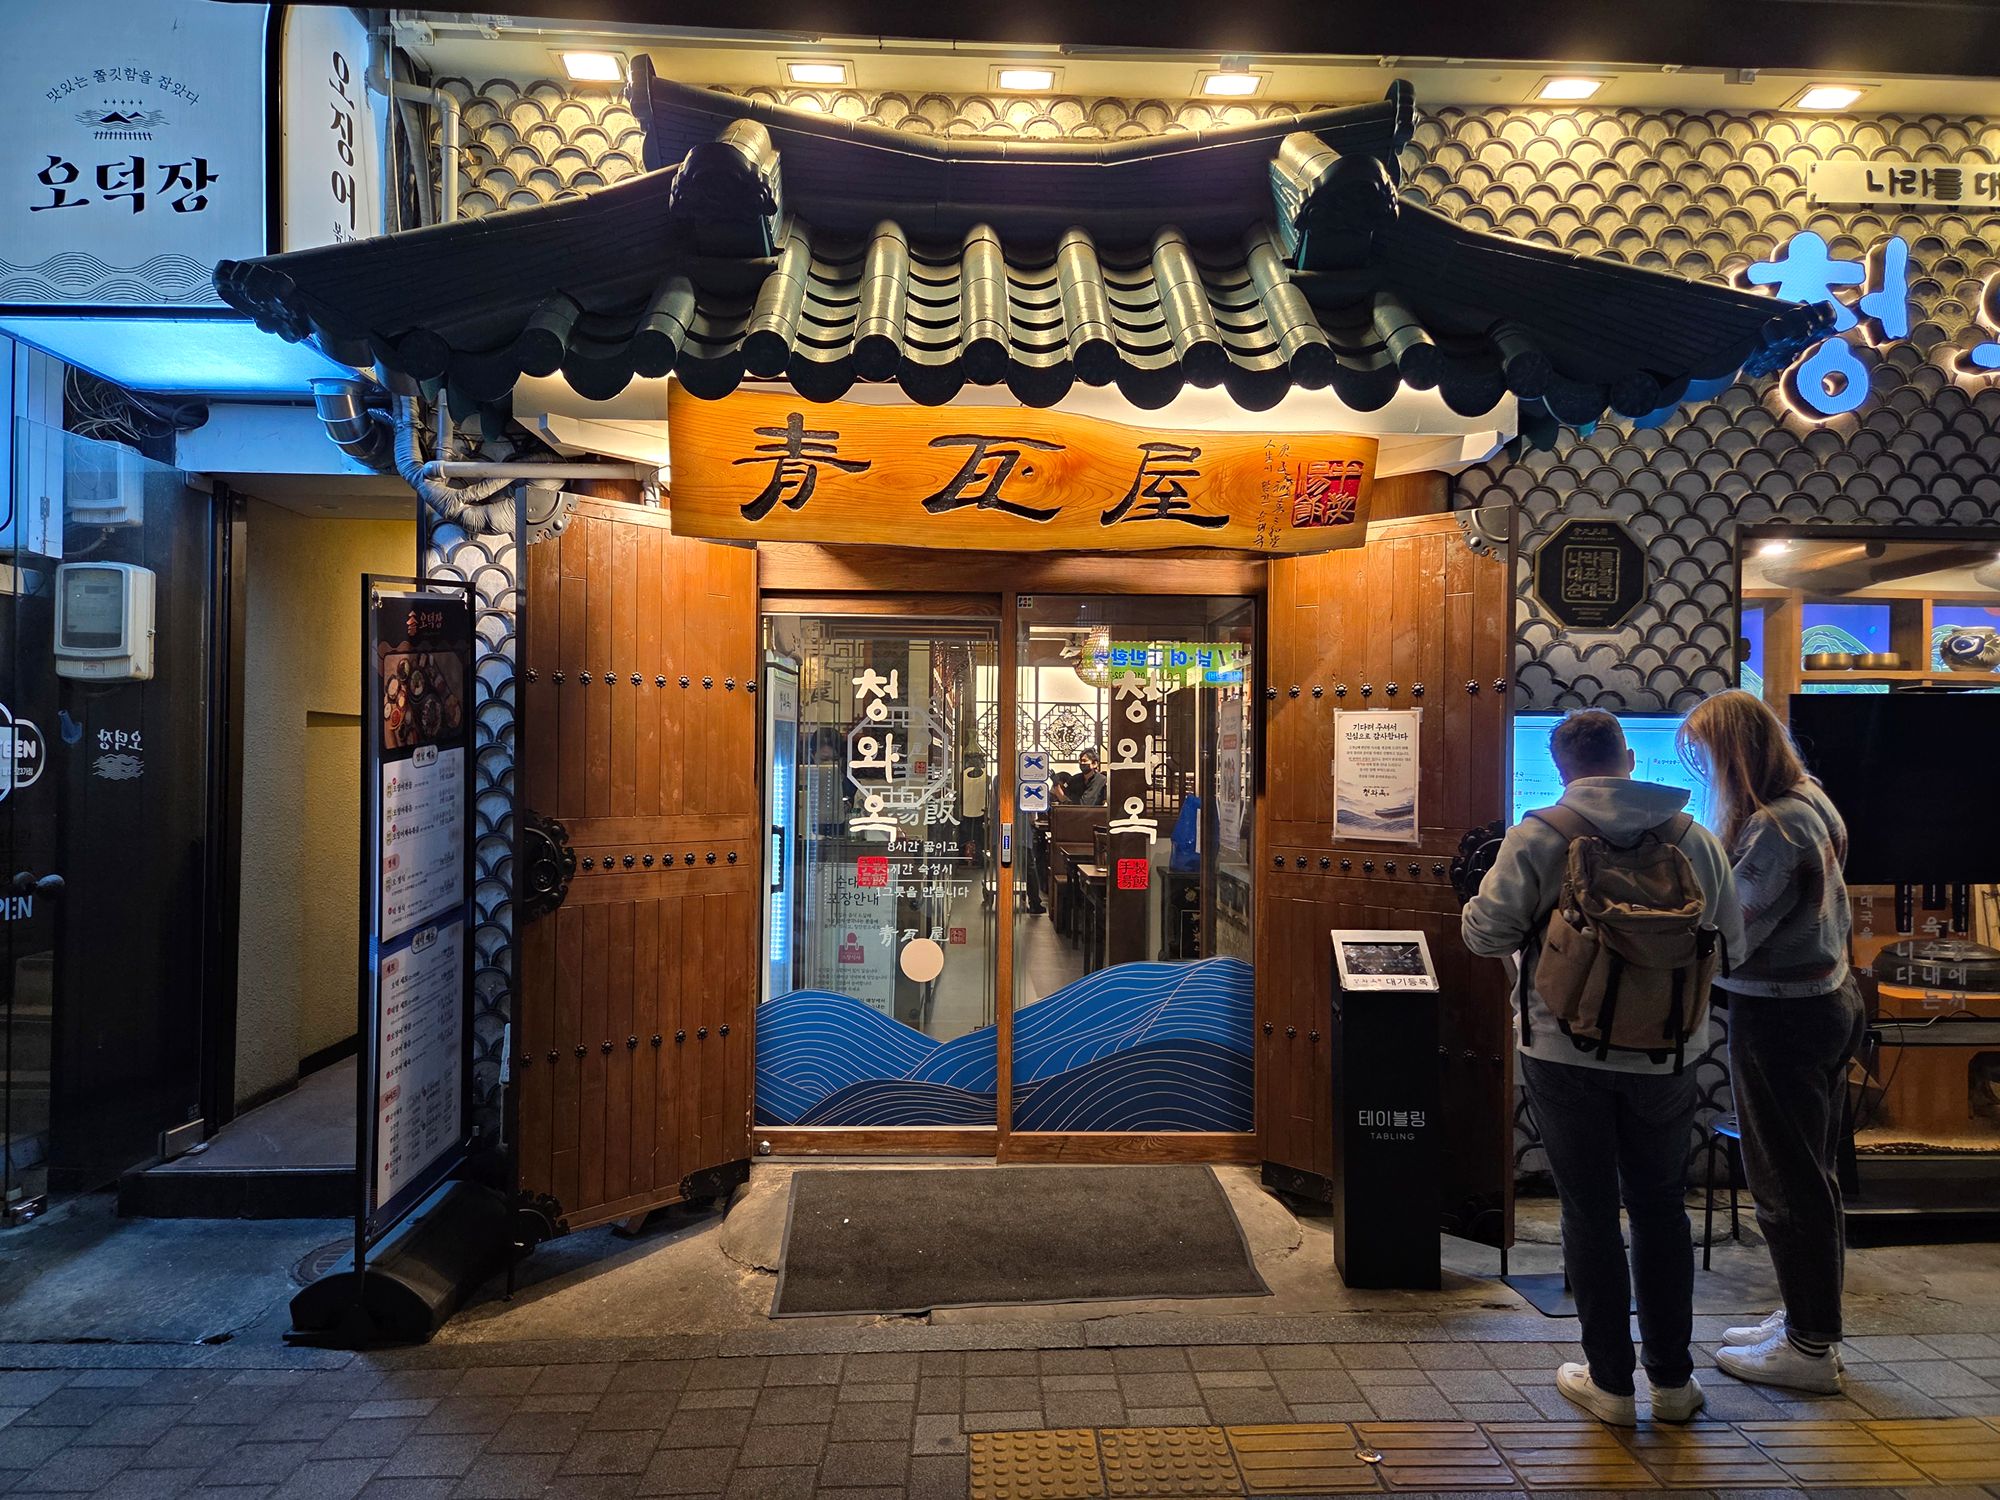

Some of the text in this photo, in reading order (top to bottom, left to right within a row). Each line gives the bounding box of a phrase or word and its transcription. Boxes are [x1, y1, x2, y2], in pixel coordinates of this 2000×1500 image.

[46, 67, 200, 107] 맛있는 쫄깃함을 잡았다
[30, 155, 220, 215] 오덕장
[1866, 168, 1963, 201] 나라를
[1353, 722, 1397, 731] 기다려 주셔서
[1345, 732, 1408, 740] 진심으로 감사합니다
[849, 668, 899, 843] 청와옥
[1109, 670, 1158, 845] 청와옥
[887, 841, 920, 853] 8시간
[887, 863, 953, 876] 시간 숙성시
[922, 886, 970, 898] 만듭니다
[1385, 977, 1429, 987] 대기등록
[1358, 1110, 1426, 1127] 테이블링
[1371, 1132, 1415, 1140] TABLING
